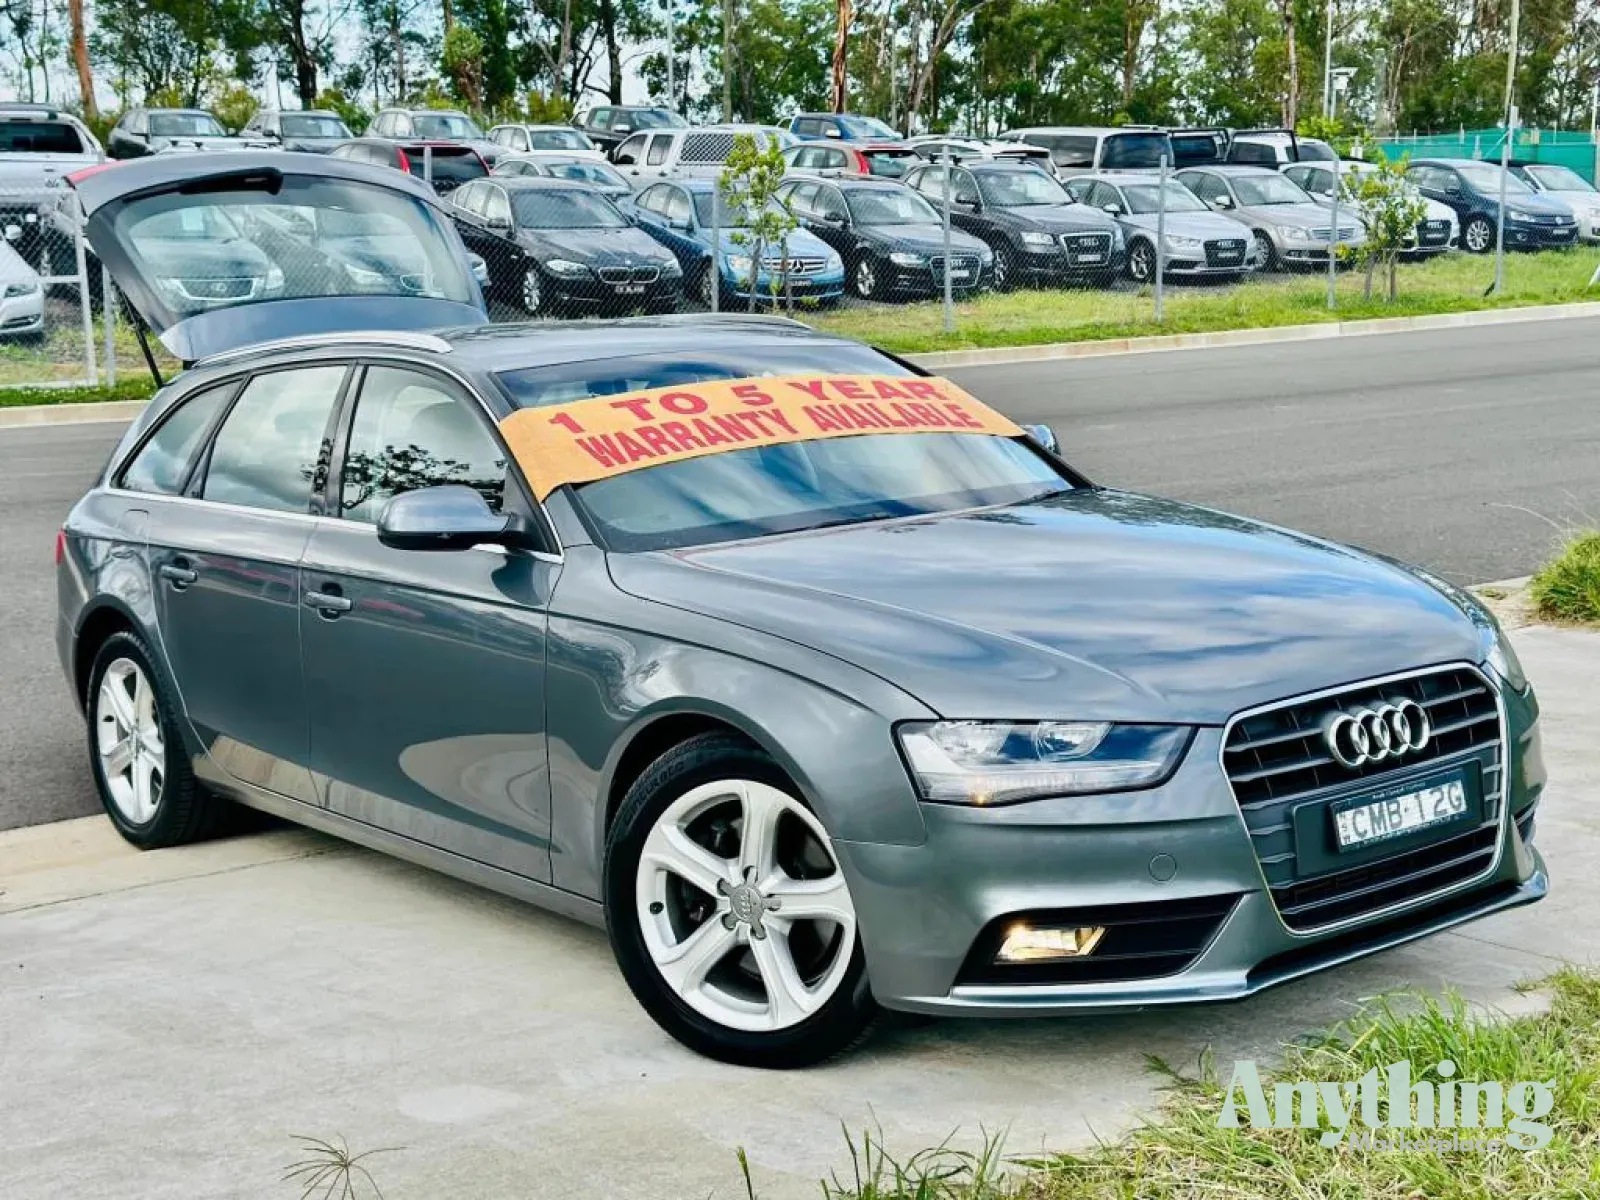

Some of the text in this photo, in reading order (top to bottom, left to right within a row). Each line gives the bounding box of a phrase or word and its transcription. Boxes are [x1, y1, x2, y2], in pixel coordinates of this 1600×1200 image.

[549, 381, 950, 434] 1 TO 5 YEAR
[575, 403, 982, 468] WARRANTY AVAILABLE
